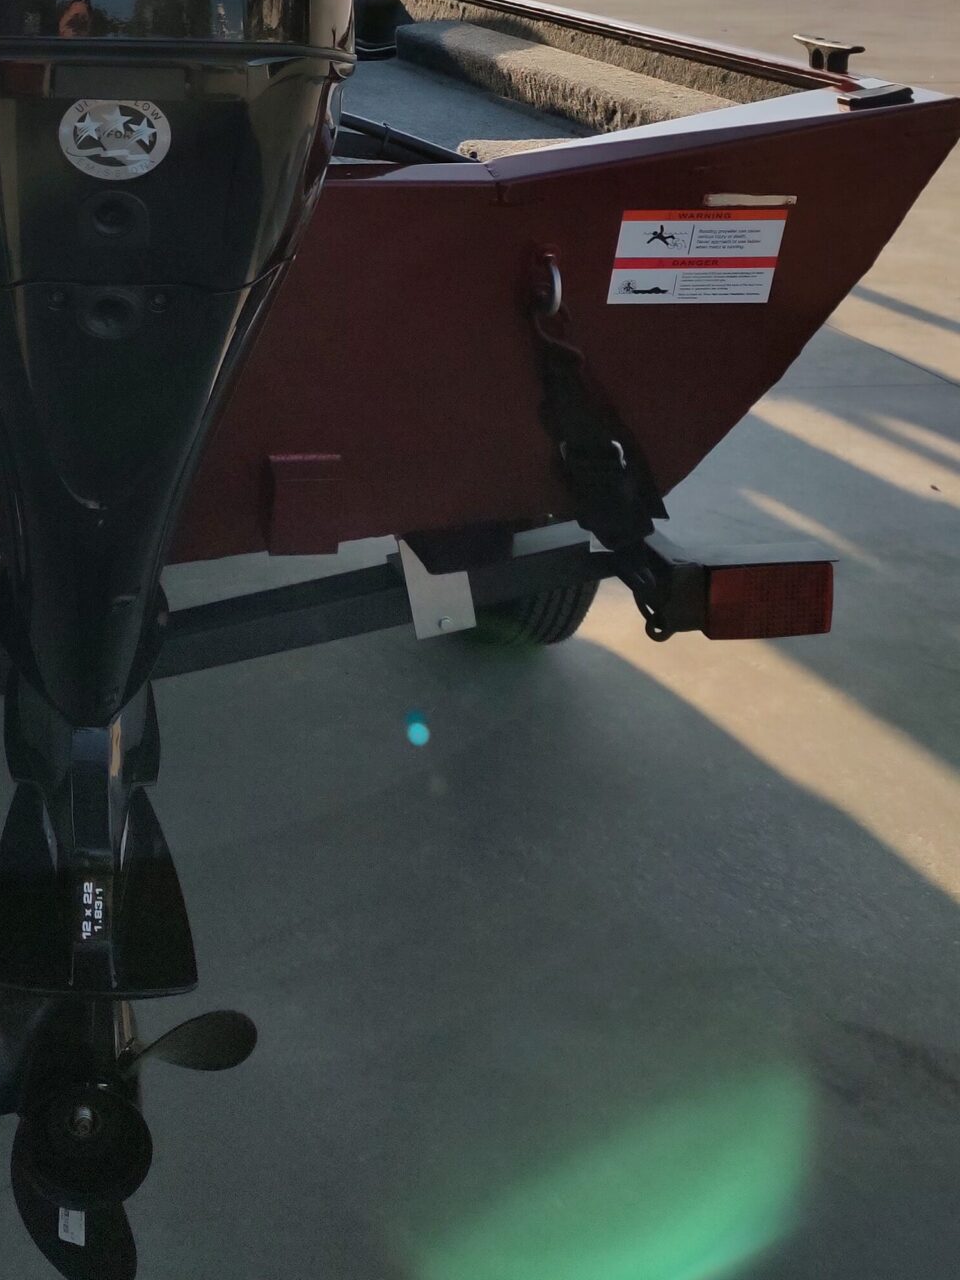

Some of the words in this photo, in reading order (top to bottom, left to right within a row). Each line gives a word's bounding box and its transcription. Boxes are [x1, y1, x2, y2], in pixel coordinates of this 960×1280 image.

[83, 881, 93, 905] 22
[84, 908, 92, 917] x
[82, 920, 92, 940] 12
